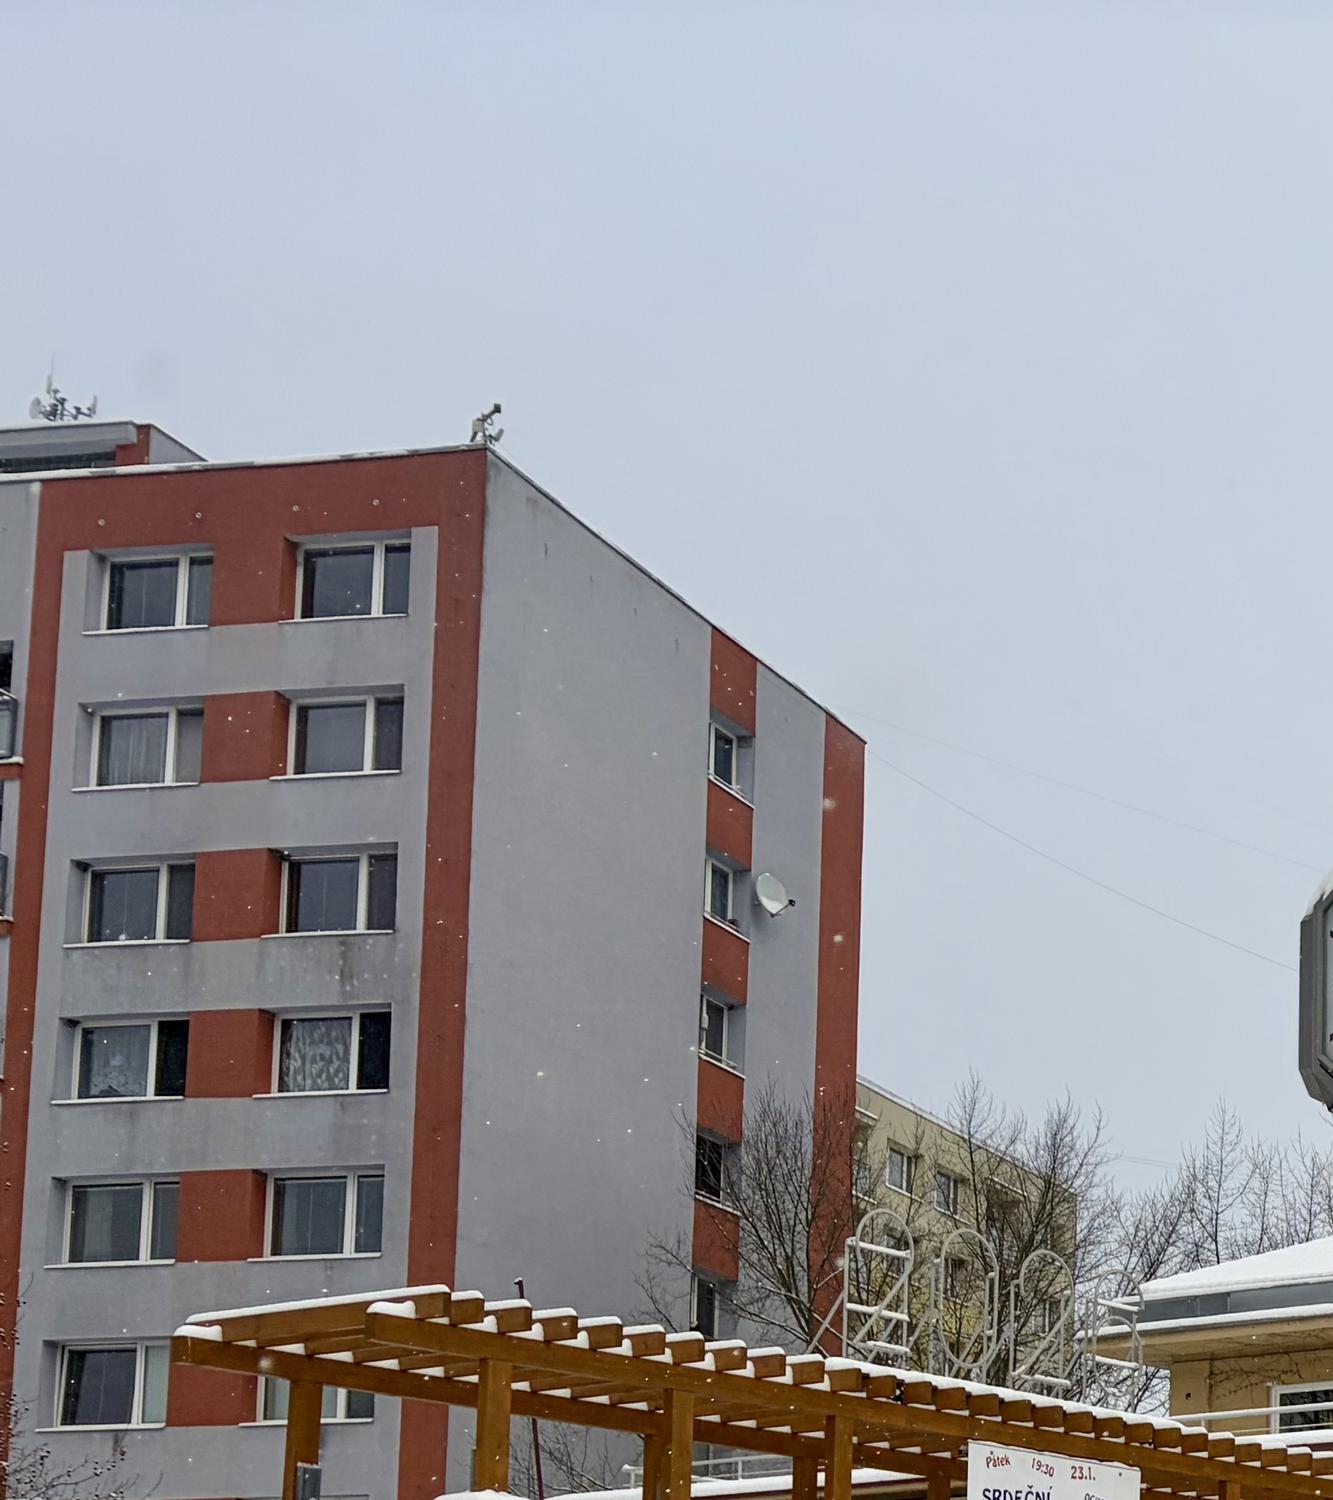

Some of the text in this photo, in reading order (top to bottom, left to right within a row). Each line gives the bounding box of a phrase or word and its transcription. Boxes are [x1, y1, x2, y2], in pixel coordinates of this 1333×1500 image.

[986, 1454, 1096, 1481] Pátek 19:30 23.1.
